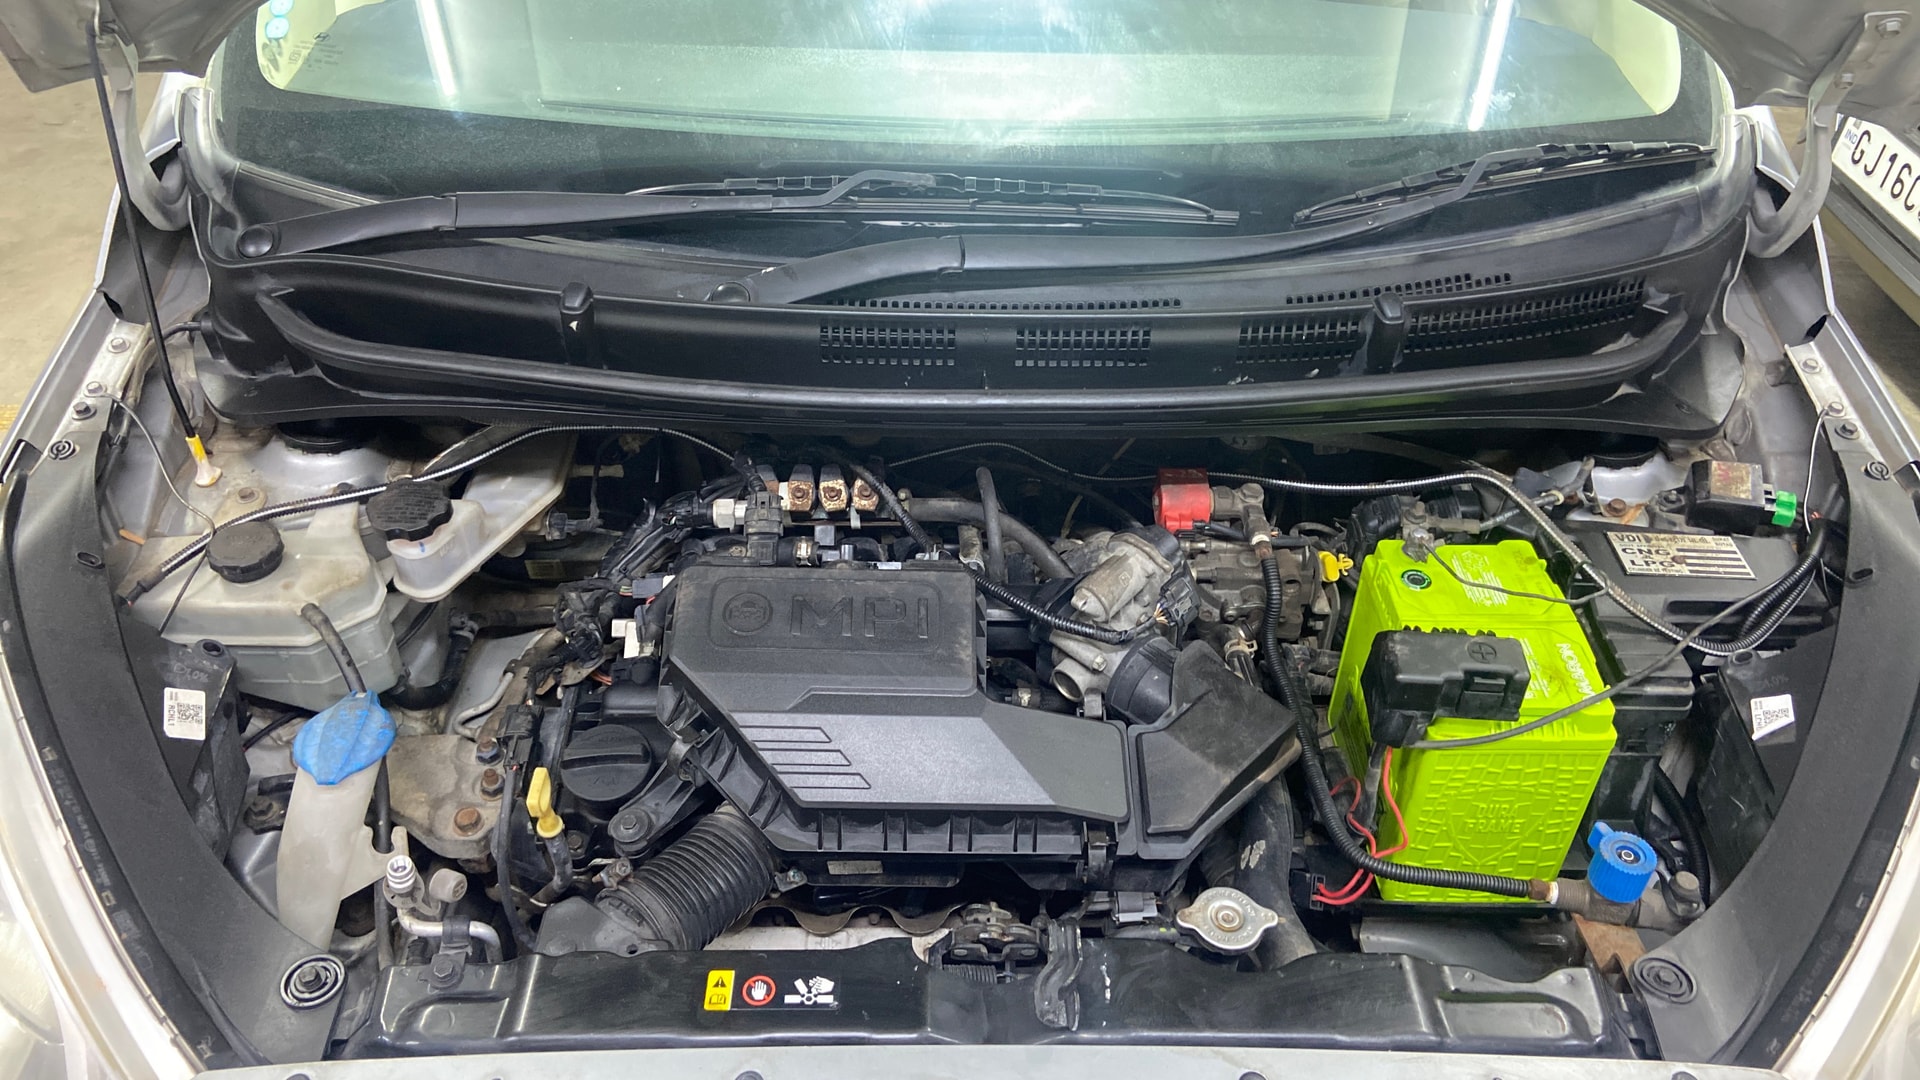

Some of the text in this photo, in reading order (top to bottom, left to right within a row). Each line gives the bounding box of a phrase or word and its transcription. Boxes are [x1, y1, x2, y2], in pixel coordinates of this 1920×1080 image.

[1844, 129, 1858, 145] IND
[1851, 130, 1920, 222] GJ16C
[1621, 547, 1671, 556] CNG
[1629, 559, 1675, 568] LPG
[789, 595, 929, 639] MPI
[1477, 803, 1520, 817] DURA
[1464, 818, 1524, 833] FRAME
